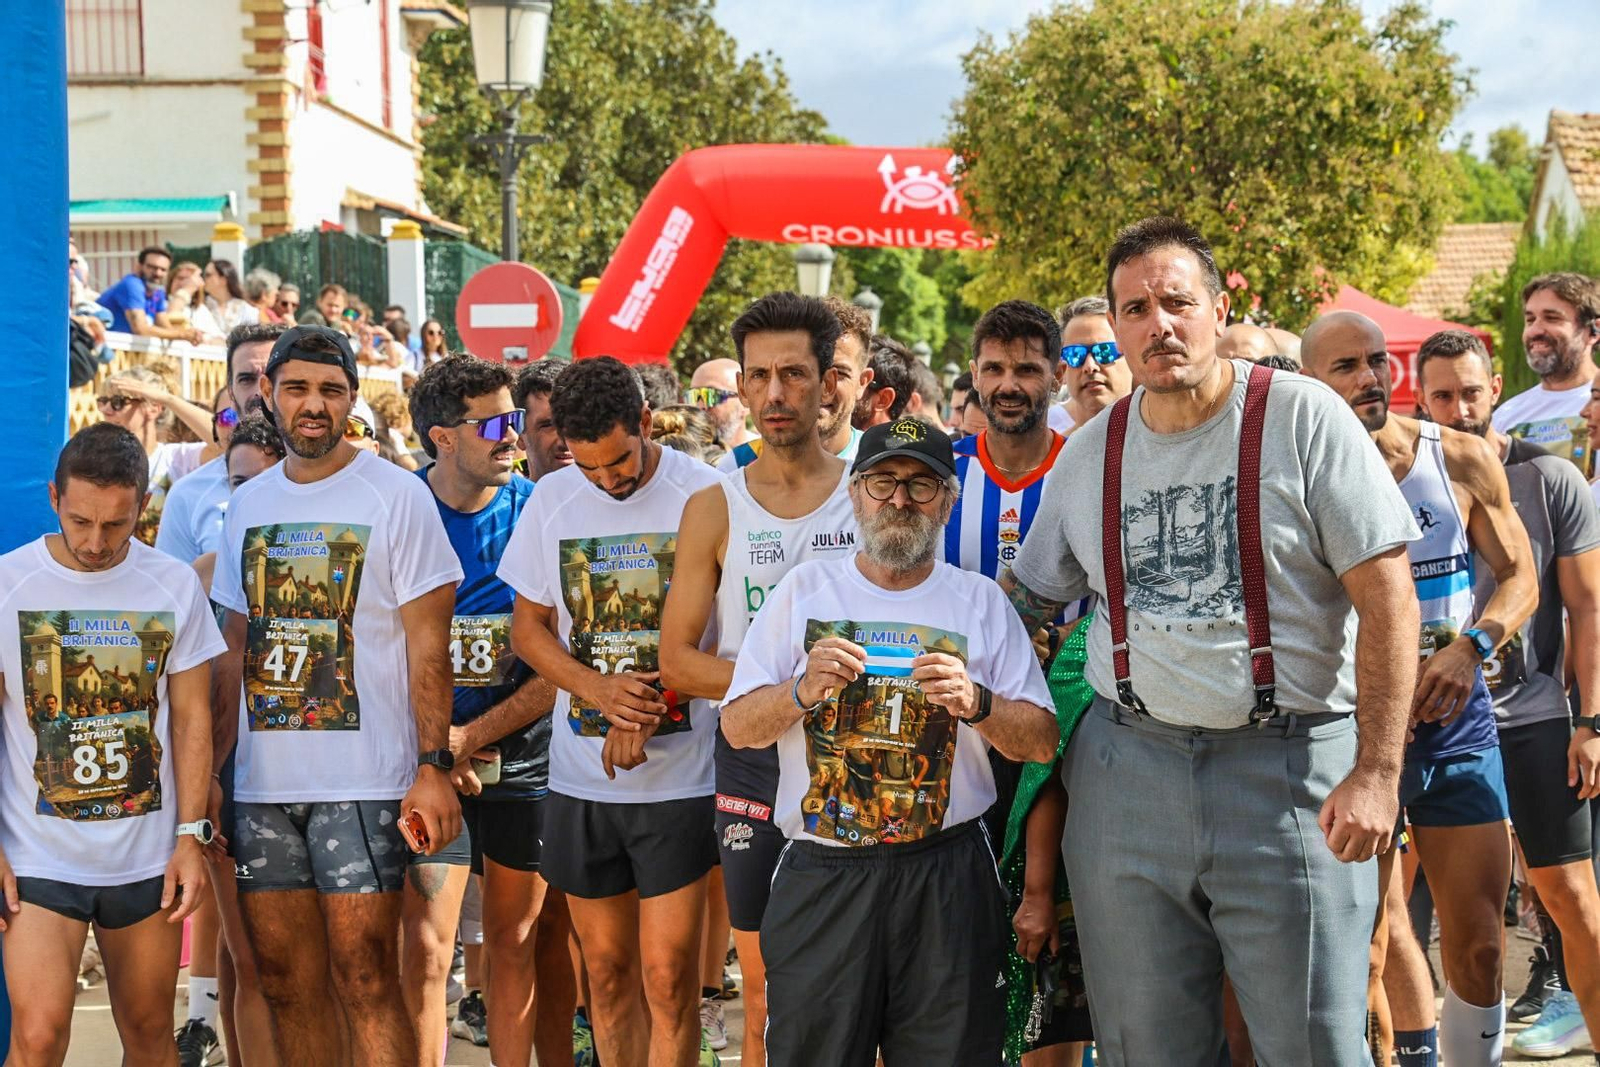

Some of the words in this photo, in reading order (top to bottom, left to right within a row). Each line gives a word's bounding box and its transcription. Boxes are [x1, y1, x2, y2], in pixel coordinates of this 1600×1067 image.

[276, 532, 286, 544] II
[289, 530, 324, 544] MILLA
[811, 530, 855, 547] JULIÁN
[596, 546, 606, 559] II
[609, 541, 649, 557] MILLA
[748, 548, 785, 565] TEAM
[69, 619, 80, 632] II
[84, 619, 131, 632] MILLA
[281, 620, 305, 630] MILLA
[458, 617, 489, 625] MILLA
[62, 632, 140, 647] BRITÁNICA
[592, 635, 602, 643] II
[603, 634, 633, 643] MILLA
[855, 630, 866, 642] II
[870, 630, 919, 645] MILLA
[263, 644, 308, 682] 47
[448, 639, 493, 674] 48
[885, 692, 904, 735] 1
[71, 721, 83, 731] II
[86, 717, 120, 729] MILLA
[73, 740, 129, 785] 85
[1396, 1045, 1432, 1055] ILA
